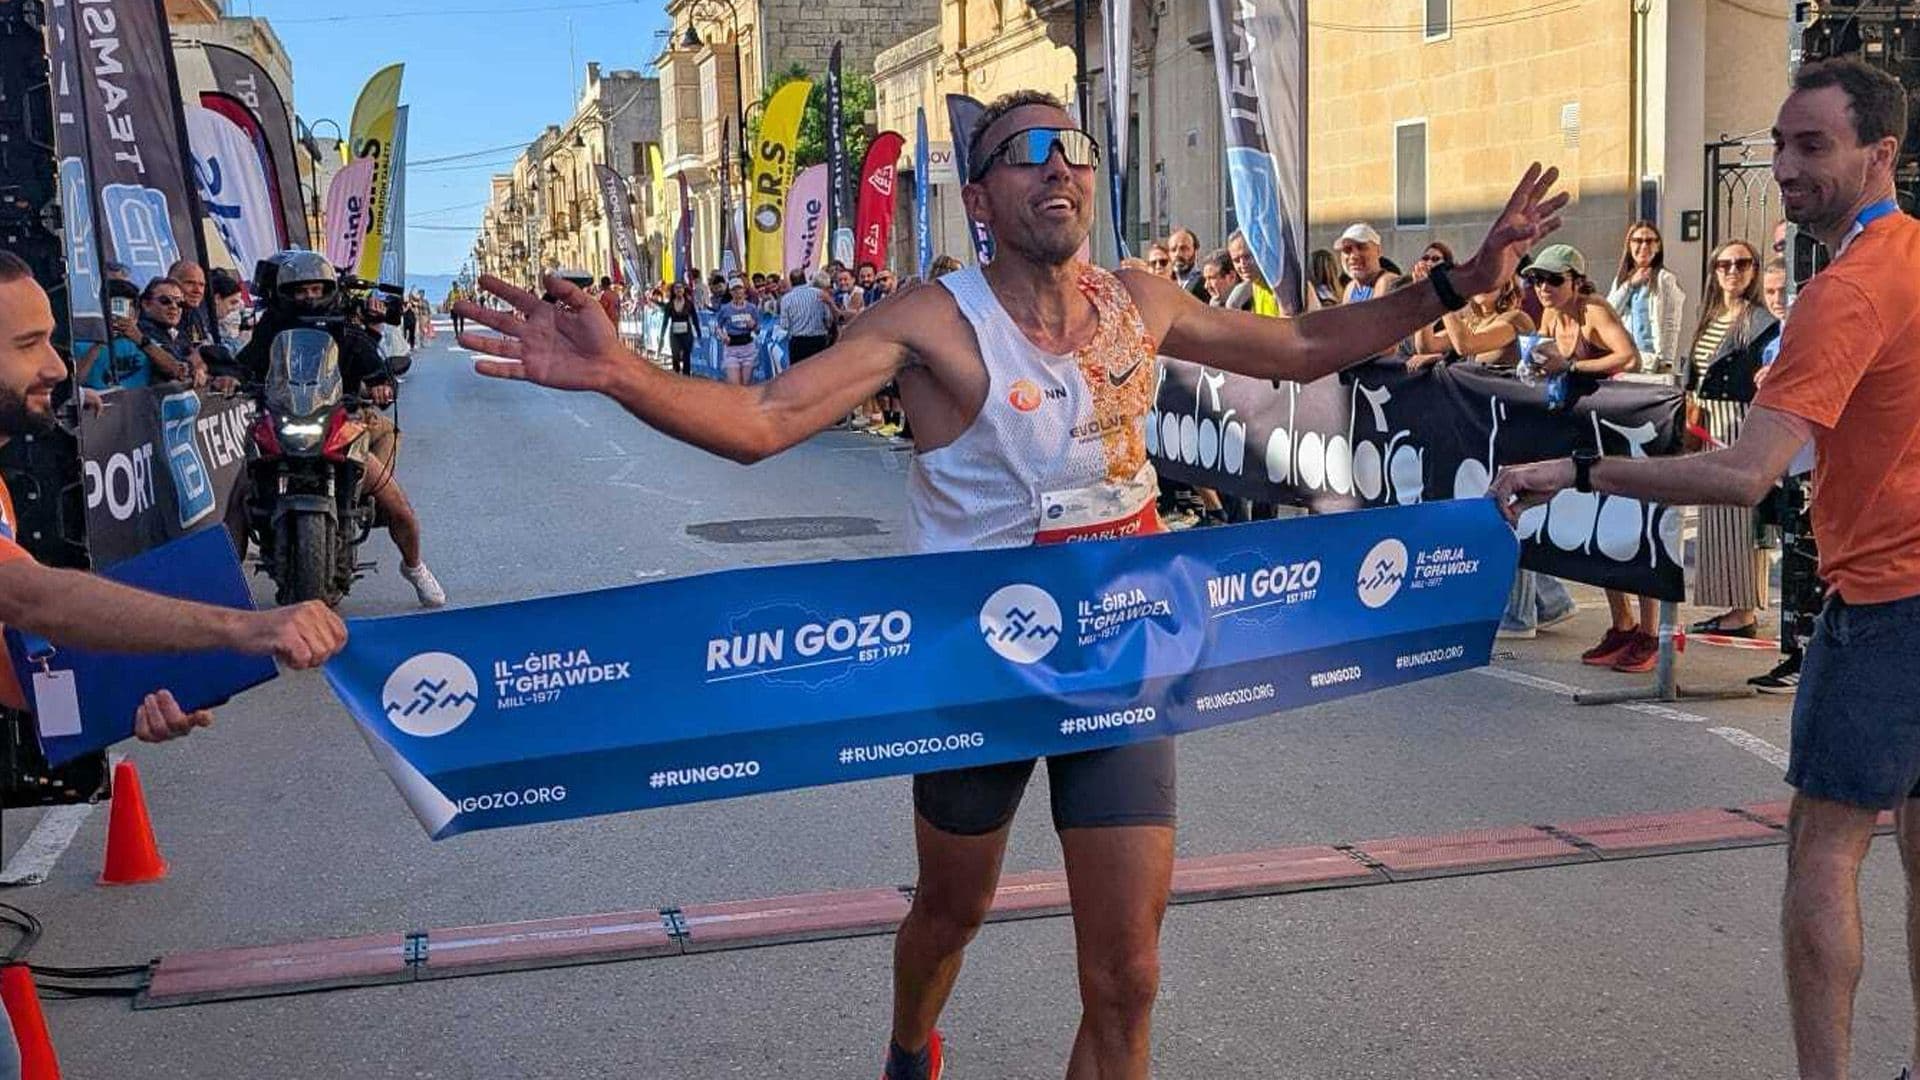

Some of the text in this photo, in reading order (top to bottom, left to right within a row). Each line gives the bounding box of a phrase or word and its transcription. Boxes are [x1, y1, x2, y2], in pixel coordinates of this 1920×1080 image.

[1044, 386, 1067, 400] NN
[1266, 379, 1425, 505] diadora
[1207, 560, 1321, 608] RUN GOZO
[707, 610, 912, 672] RUN GOZO
[859, 643, 911, 662] EST 1977
[497, 689, 560, 709] MILL-1977
[457, 785, 567, 815] GOZO.ORG
[649, 760, 761, 789] #RUNGOZO
[838, 732, 984, 765] #RUNGOZO.ORG
[1059, 706, 1157, 736] #RUNGOZO
[1196, 683, 1275, 713] #RUNGOZO.ORG
[1310, 665, 1362, 689] #RUNGOZO
